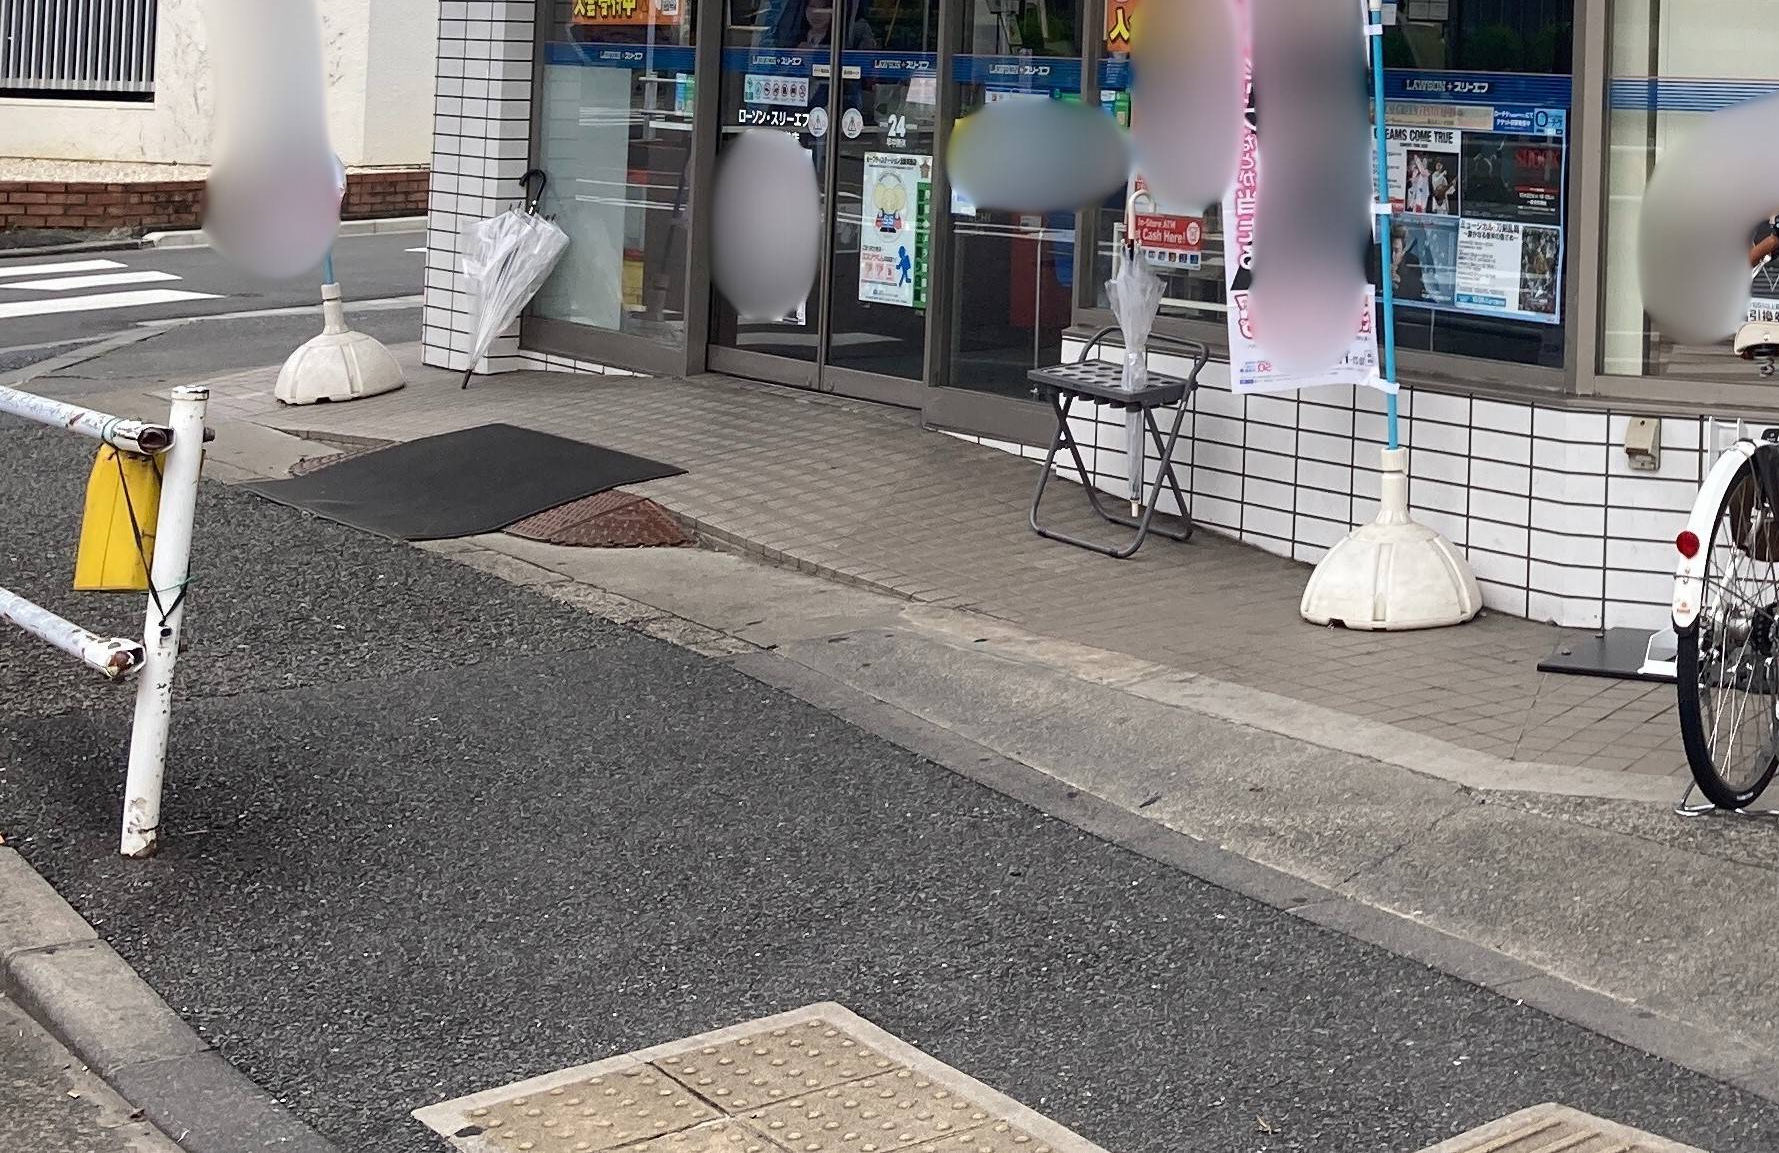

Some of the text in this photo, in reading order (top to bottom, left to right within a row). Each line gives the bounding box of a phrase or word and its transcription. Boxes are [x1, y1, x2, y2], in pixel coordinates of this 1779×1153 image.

[1453, 81, 1489, 93] スリーエフ
[739, 109, 810, 127] ローソン・スリーエフ
[887, 113, 906, 138] 24
[1410, 130, 1432, 142] COME
[1433, 131, 1454, 144] TRUE
[1142, 228, 1162, 241] Cash
[1163, 230, 1186, 243] Here!
